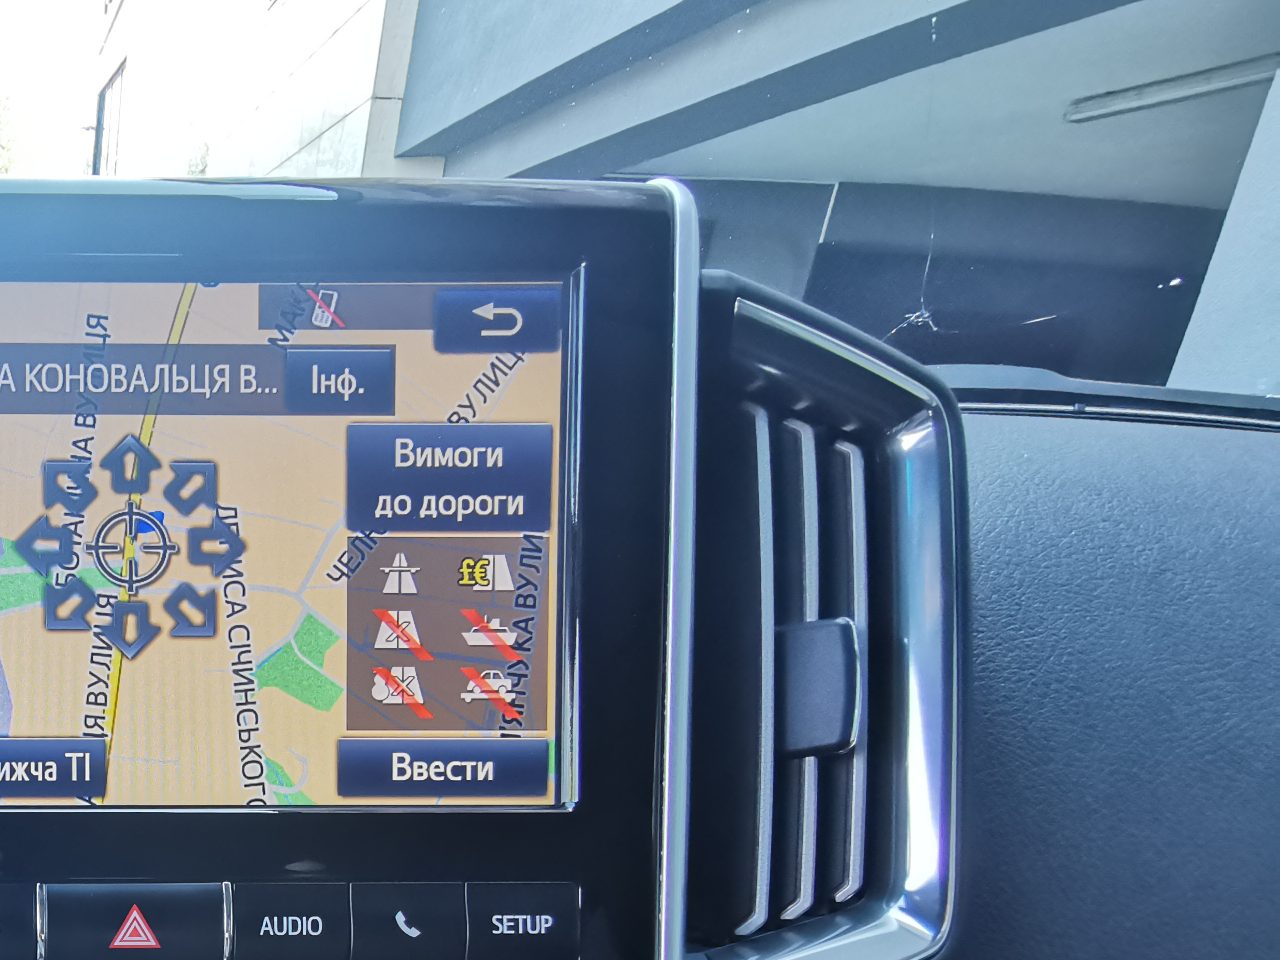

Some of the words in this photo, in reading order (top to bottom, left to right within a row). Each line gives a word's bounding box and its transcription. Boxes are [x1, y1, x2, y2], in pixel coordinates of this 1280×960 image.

[24, 363, 231, 398] КОНОВАЛЬЦЯ
[311, 365, 365, 402] Інф.
[394, 438, 504, 468] Вимоги
[375, 494, 411, 519] до
[420, 495, 525, 521] дороги
[391, 751, 495, 782] Ввести
[260, 915, 323, 937] AUDIO
[491, 914, 554, 935] SETUP
